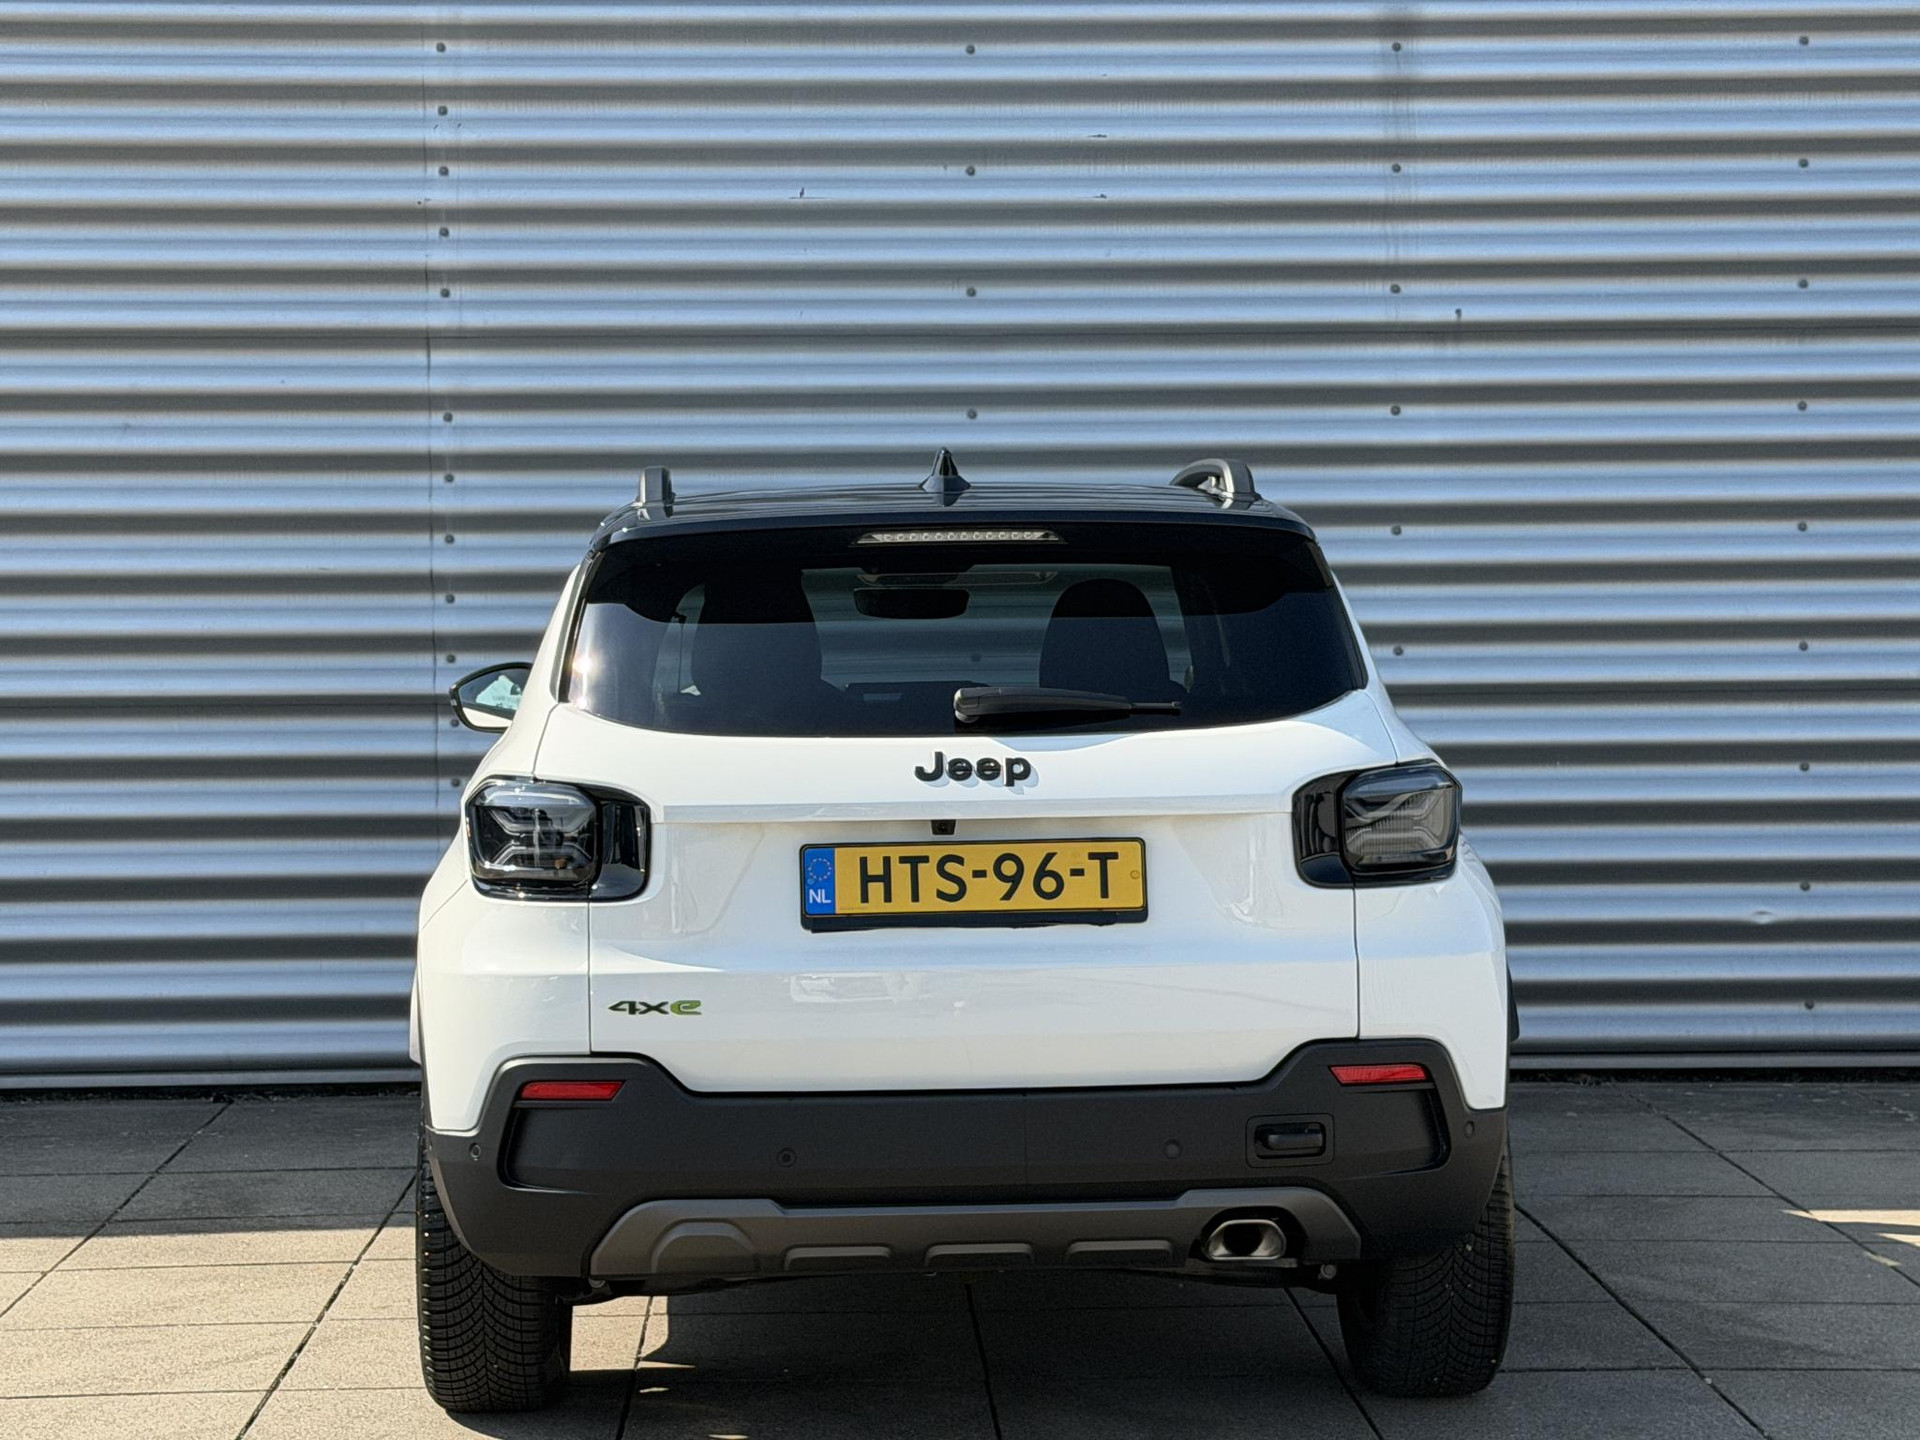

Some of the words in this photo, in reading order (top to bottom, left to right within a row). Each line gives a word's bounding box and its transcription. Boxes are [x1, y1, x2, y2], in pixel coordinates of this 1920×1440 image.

[914, 751, 1032, 787] Jeep
[859, 852, 1119, 903] HTS-96-T
[809, 889, 832, 904] NL
